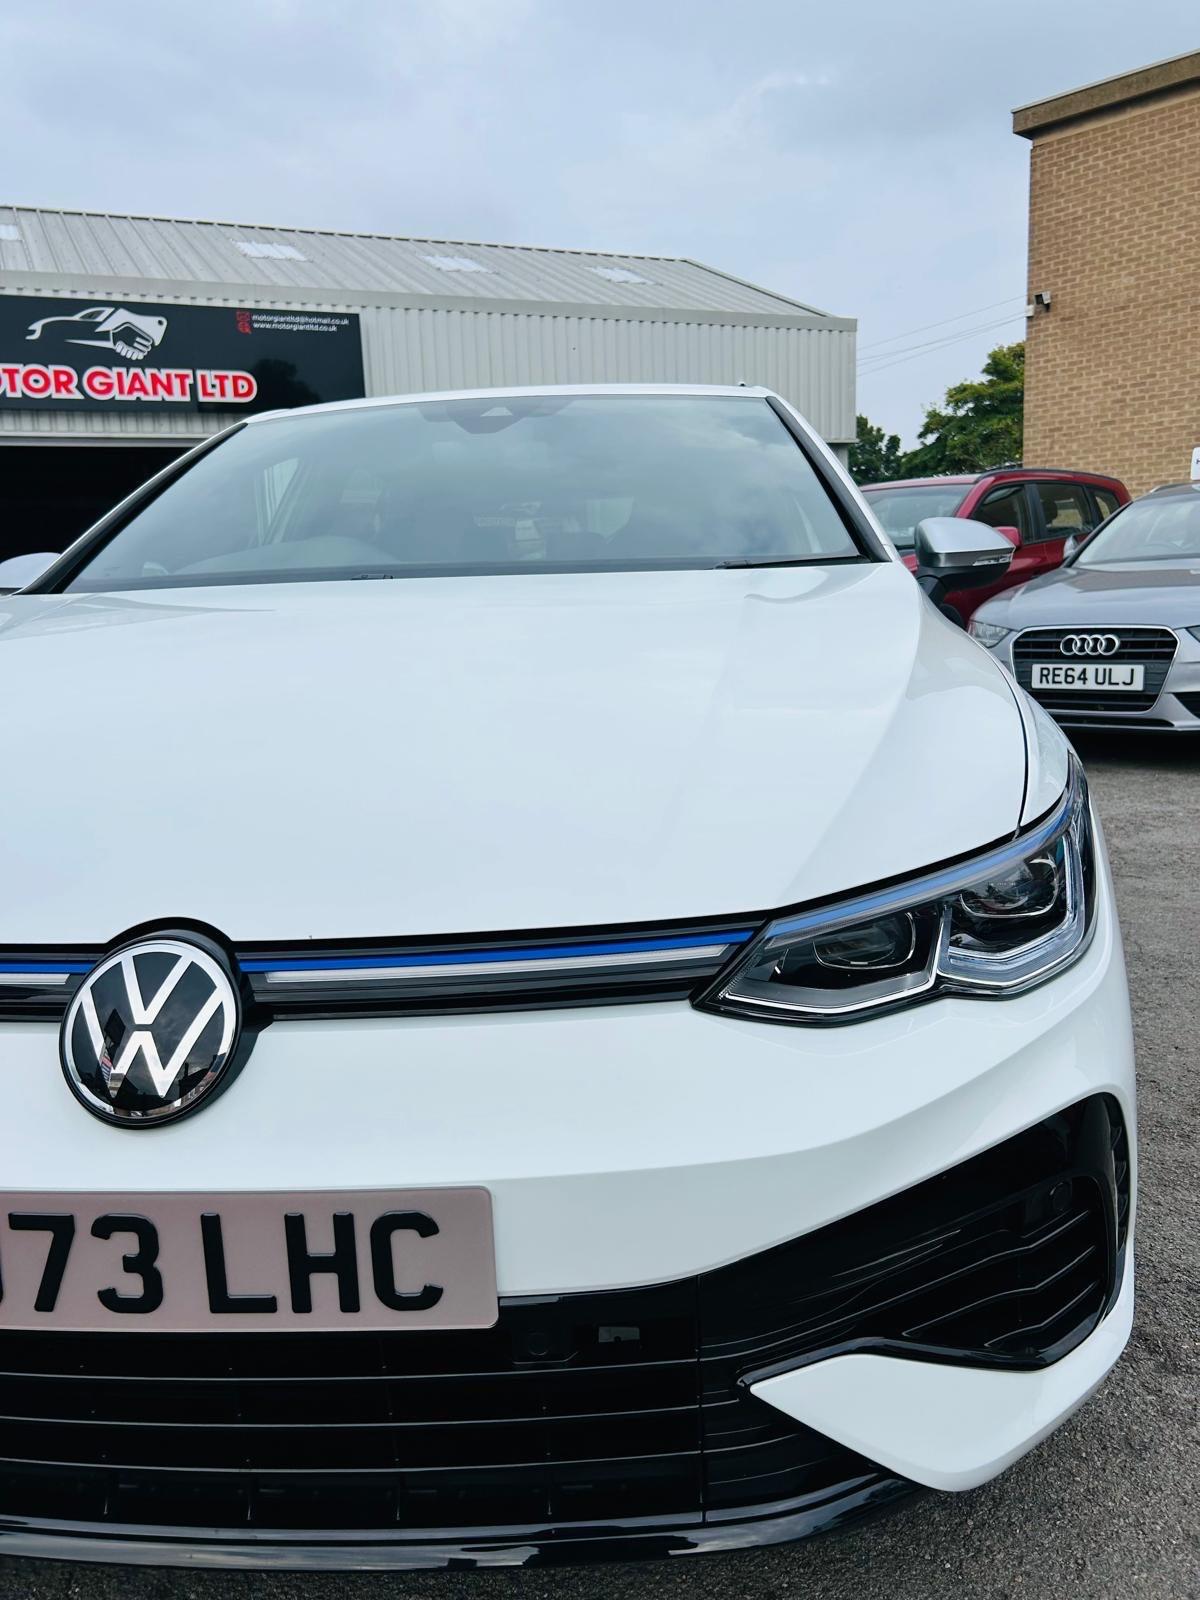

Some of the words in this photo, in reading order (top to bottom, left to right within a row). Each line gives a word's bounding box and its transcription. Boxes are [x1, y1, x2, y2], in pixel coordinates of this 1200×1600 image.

[0, 364, 82, 398] TOR
[84, 366, 193, 401] GIANT
[197, 369, 257, 403] LTD
[1039, 667, 1088, 685] RE64
[1094, 668, 1134, 686] ULJ
[0, 1211, 163, 1314] 73
[200, 1210, 443, 1314] LHC
